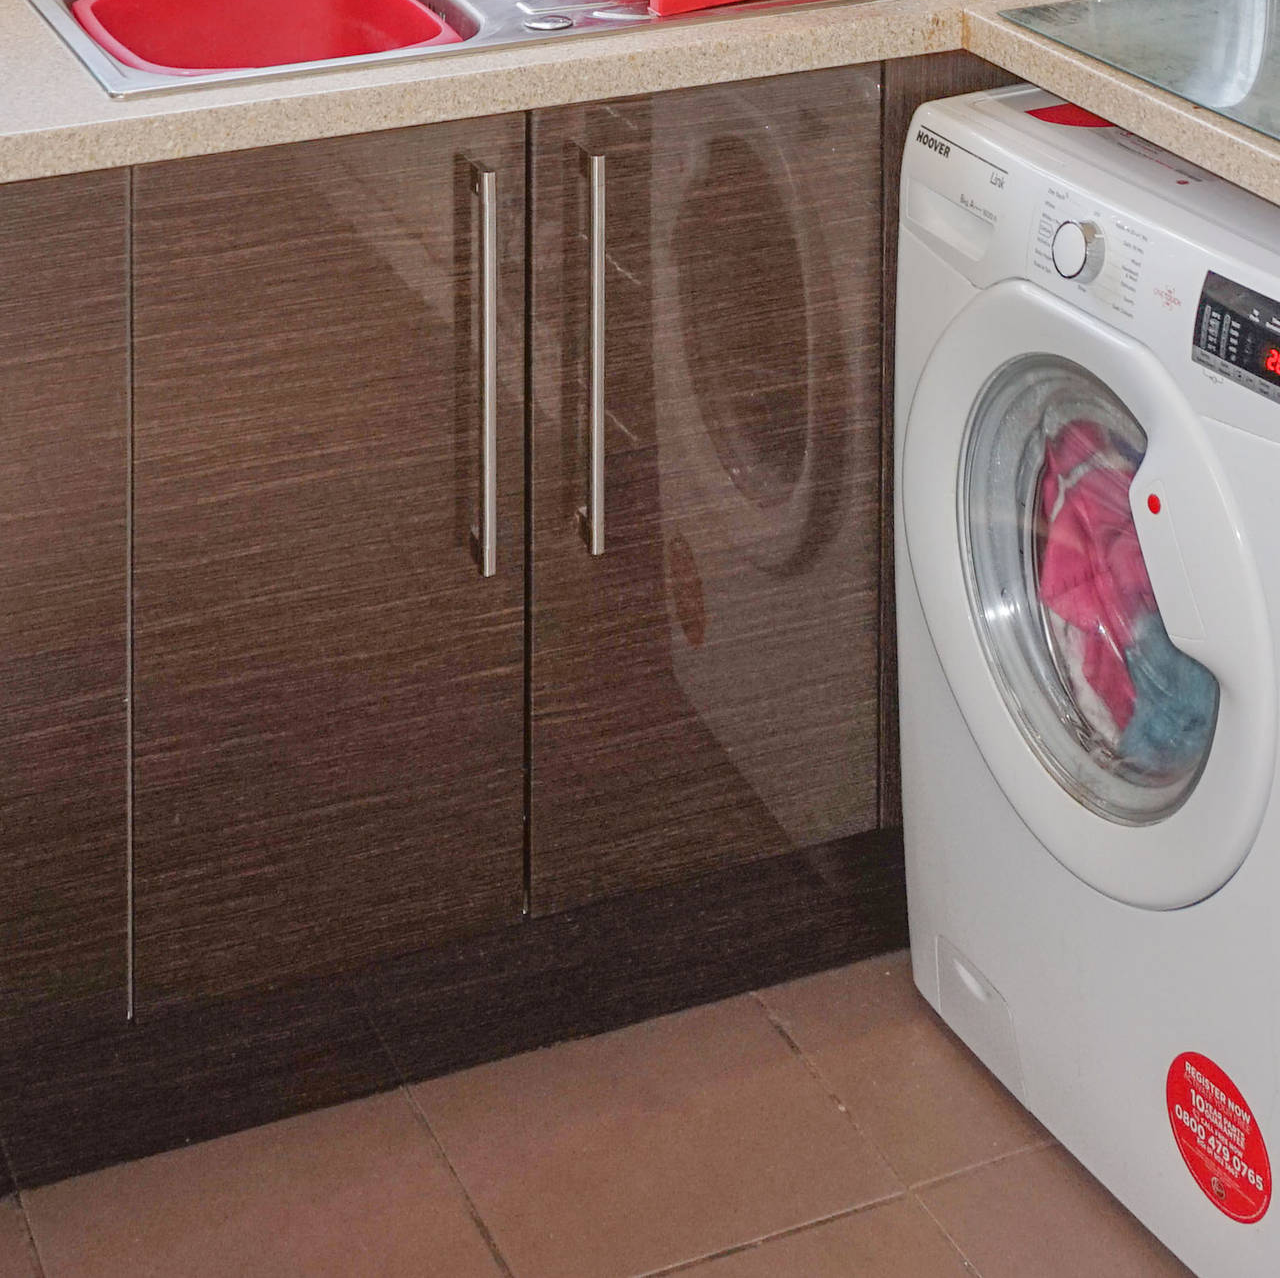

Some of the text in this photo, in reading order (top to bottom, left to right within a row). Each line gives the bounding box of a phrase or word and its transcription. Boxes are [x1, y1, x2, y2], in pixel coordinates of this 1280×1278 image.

[916, 130, 951, 159] HOOVER
[1185, 1061, 1251, 1125] REGISTER NOW
[1190, 1088, 1205, 1113] 10
[1175, 1104, 1206, 1140] 0800
[1208, 1135, 1231, 1162] 479
[1232, 1155, 1264, 1191] 0765
